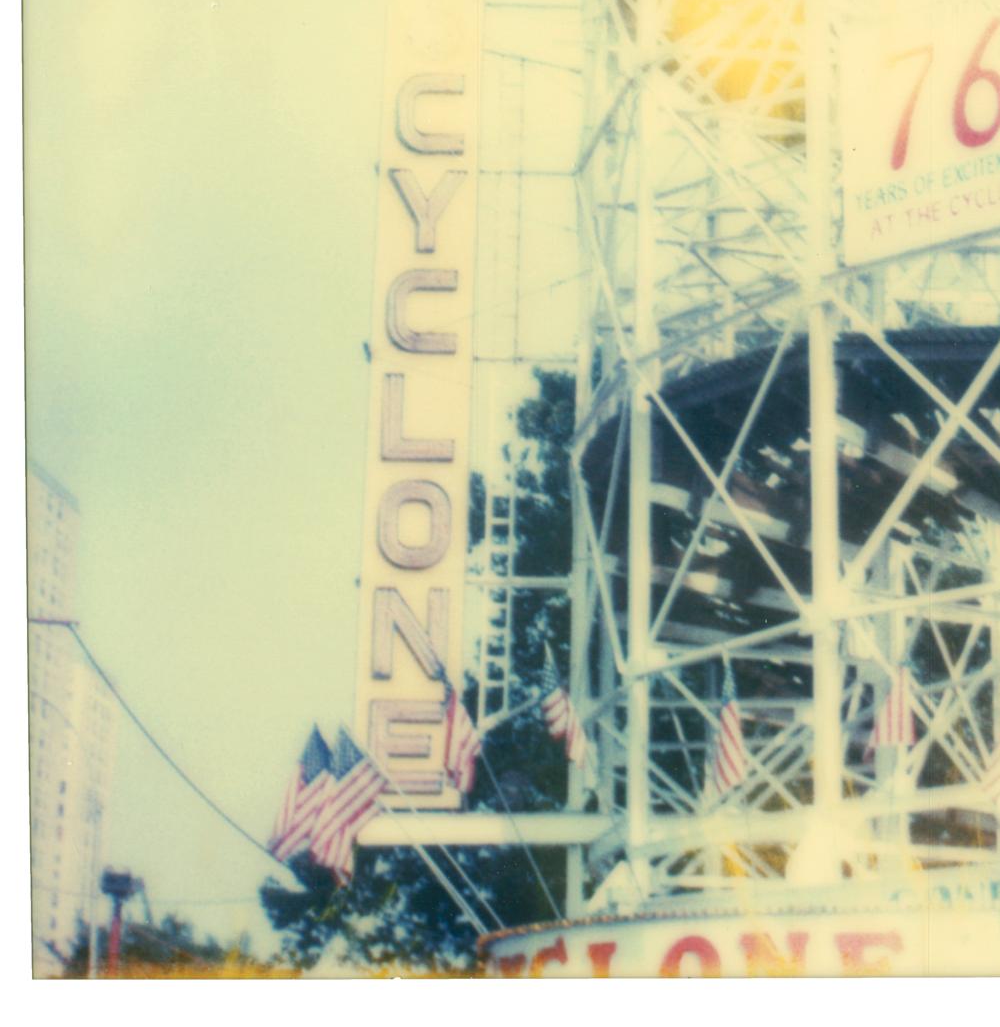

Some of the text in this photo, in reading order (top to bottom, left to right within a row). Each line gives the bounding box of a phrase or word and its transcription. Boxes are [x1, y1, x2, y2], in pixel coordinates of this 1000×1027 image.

[854, 178, 908, 211] YEARS
[913, 171, 937, 196] OF
[869, 212, 895, 240] AT
[904, 200, 941, 229] THE
[367, 72, 468, 796] CYCLONE
